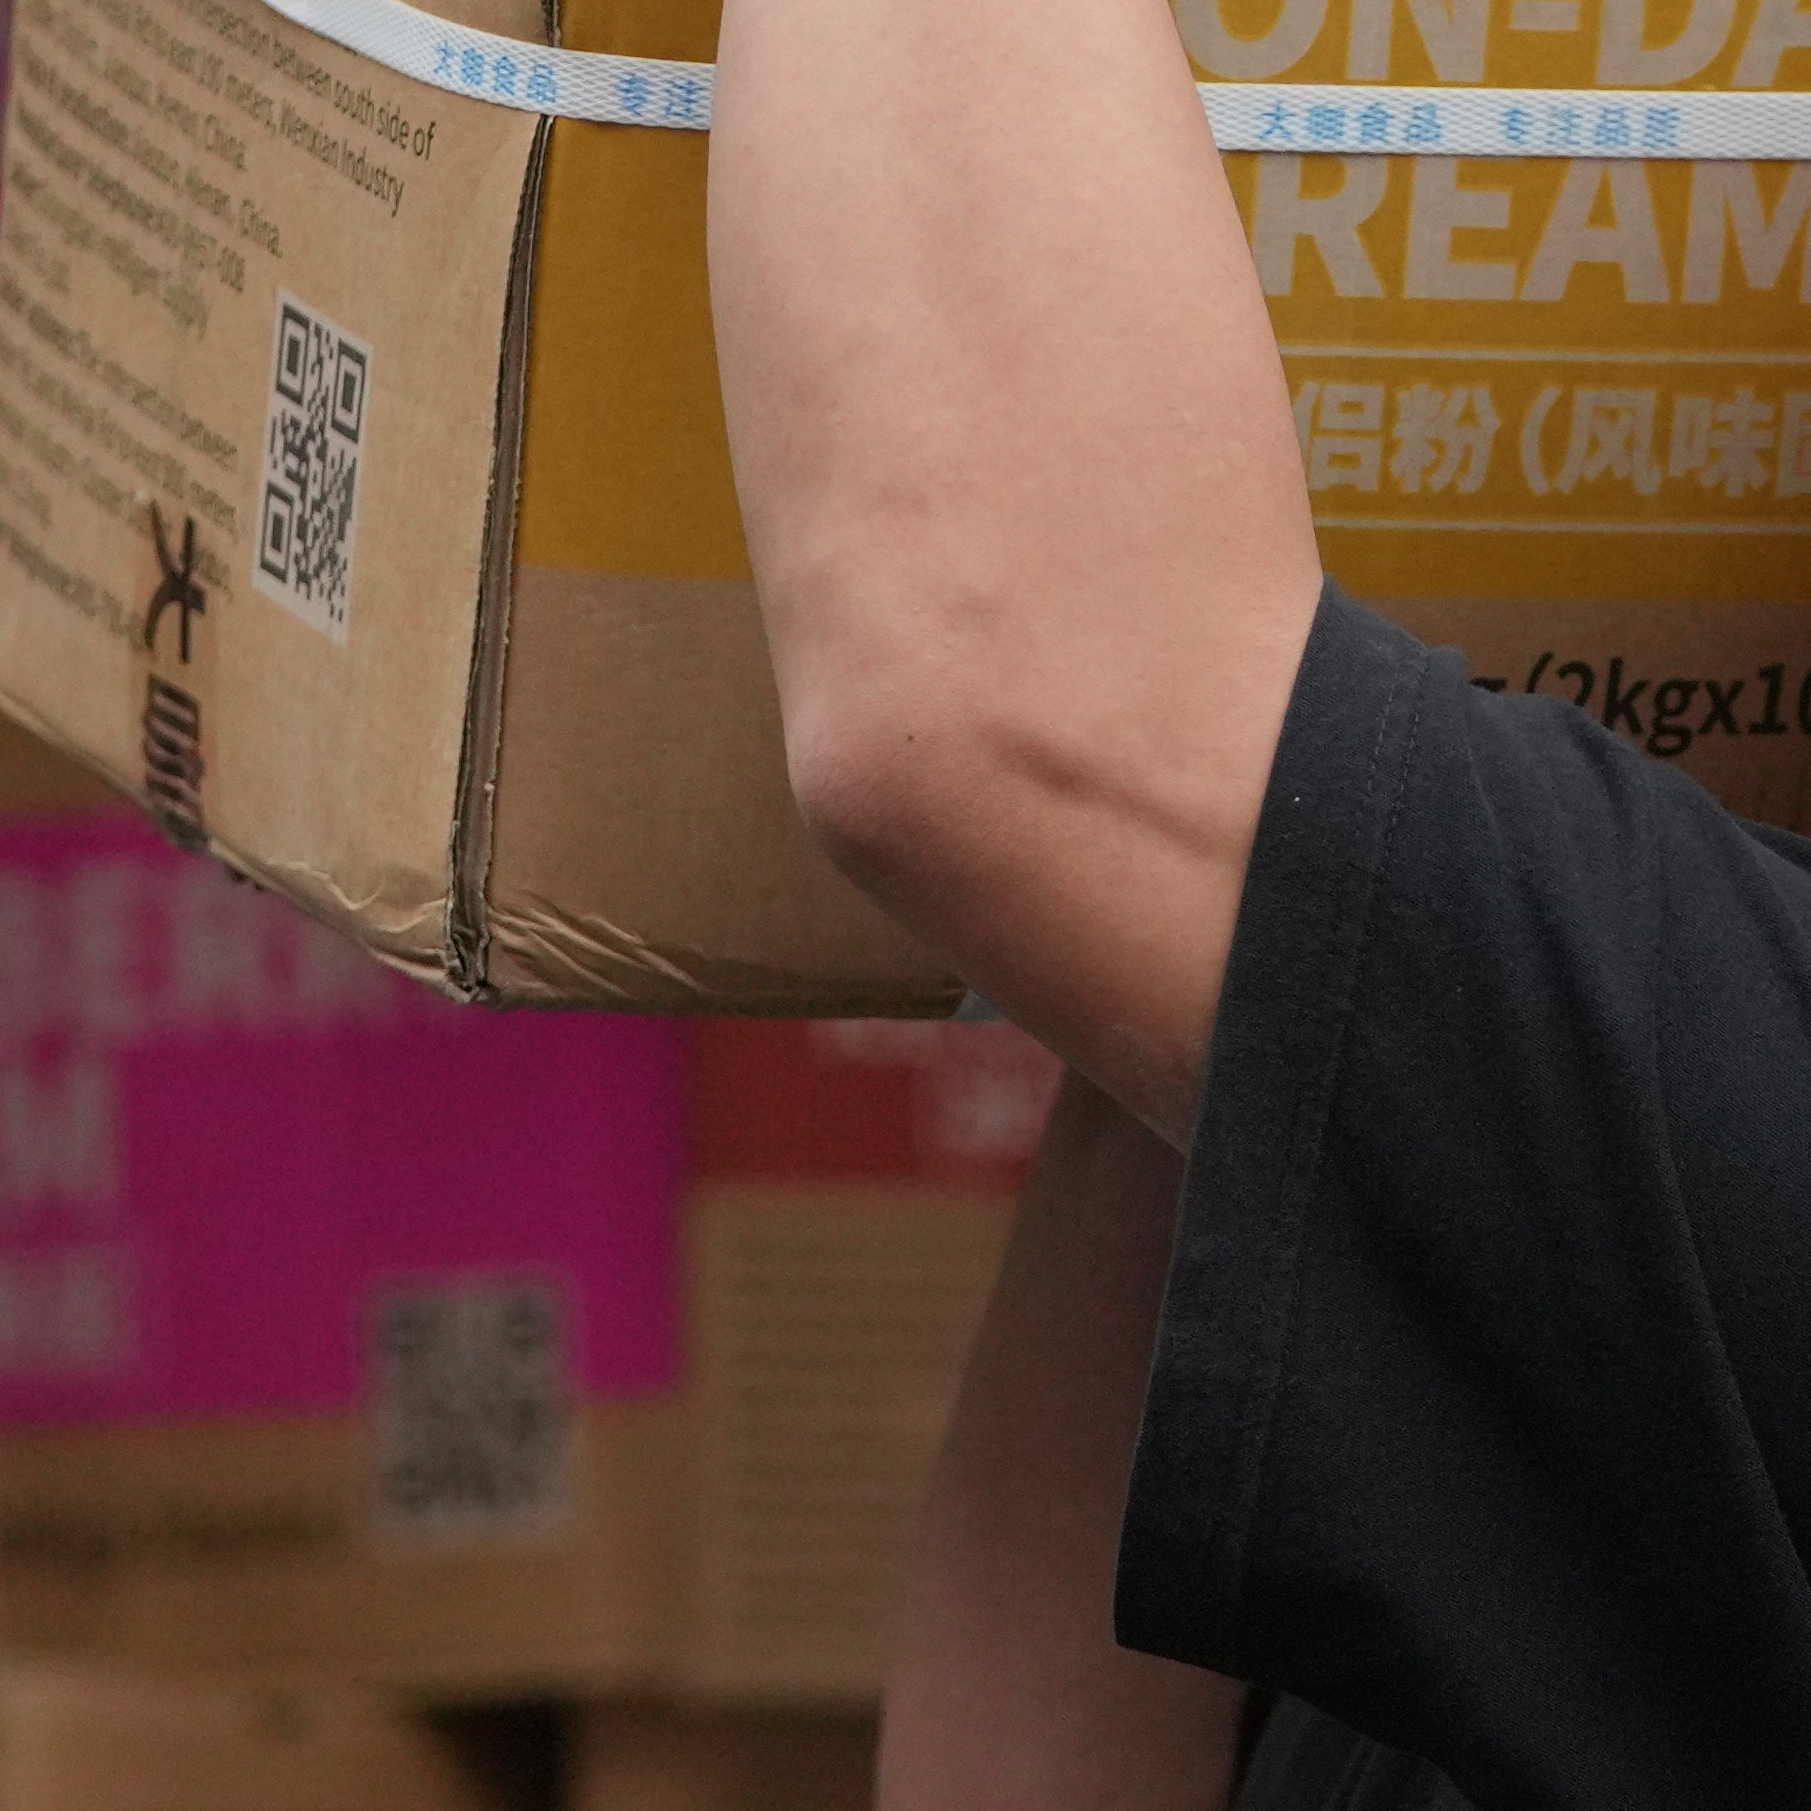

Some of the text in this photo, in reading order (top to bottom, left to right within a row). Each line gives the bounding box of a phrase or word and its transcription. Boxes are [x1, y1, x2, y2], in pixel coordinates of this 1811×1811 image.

[333, 75, 375, 131] south
[376, 100, 410, 150] side
[412, 119, 437, 162] of
[340, 143, 405, 218] Industry
